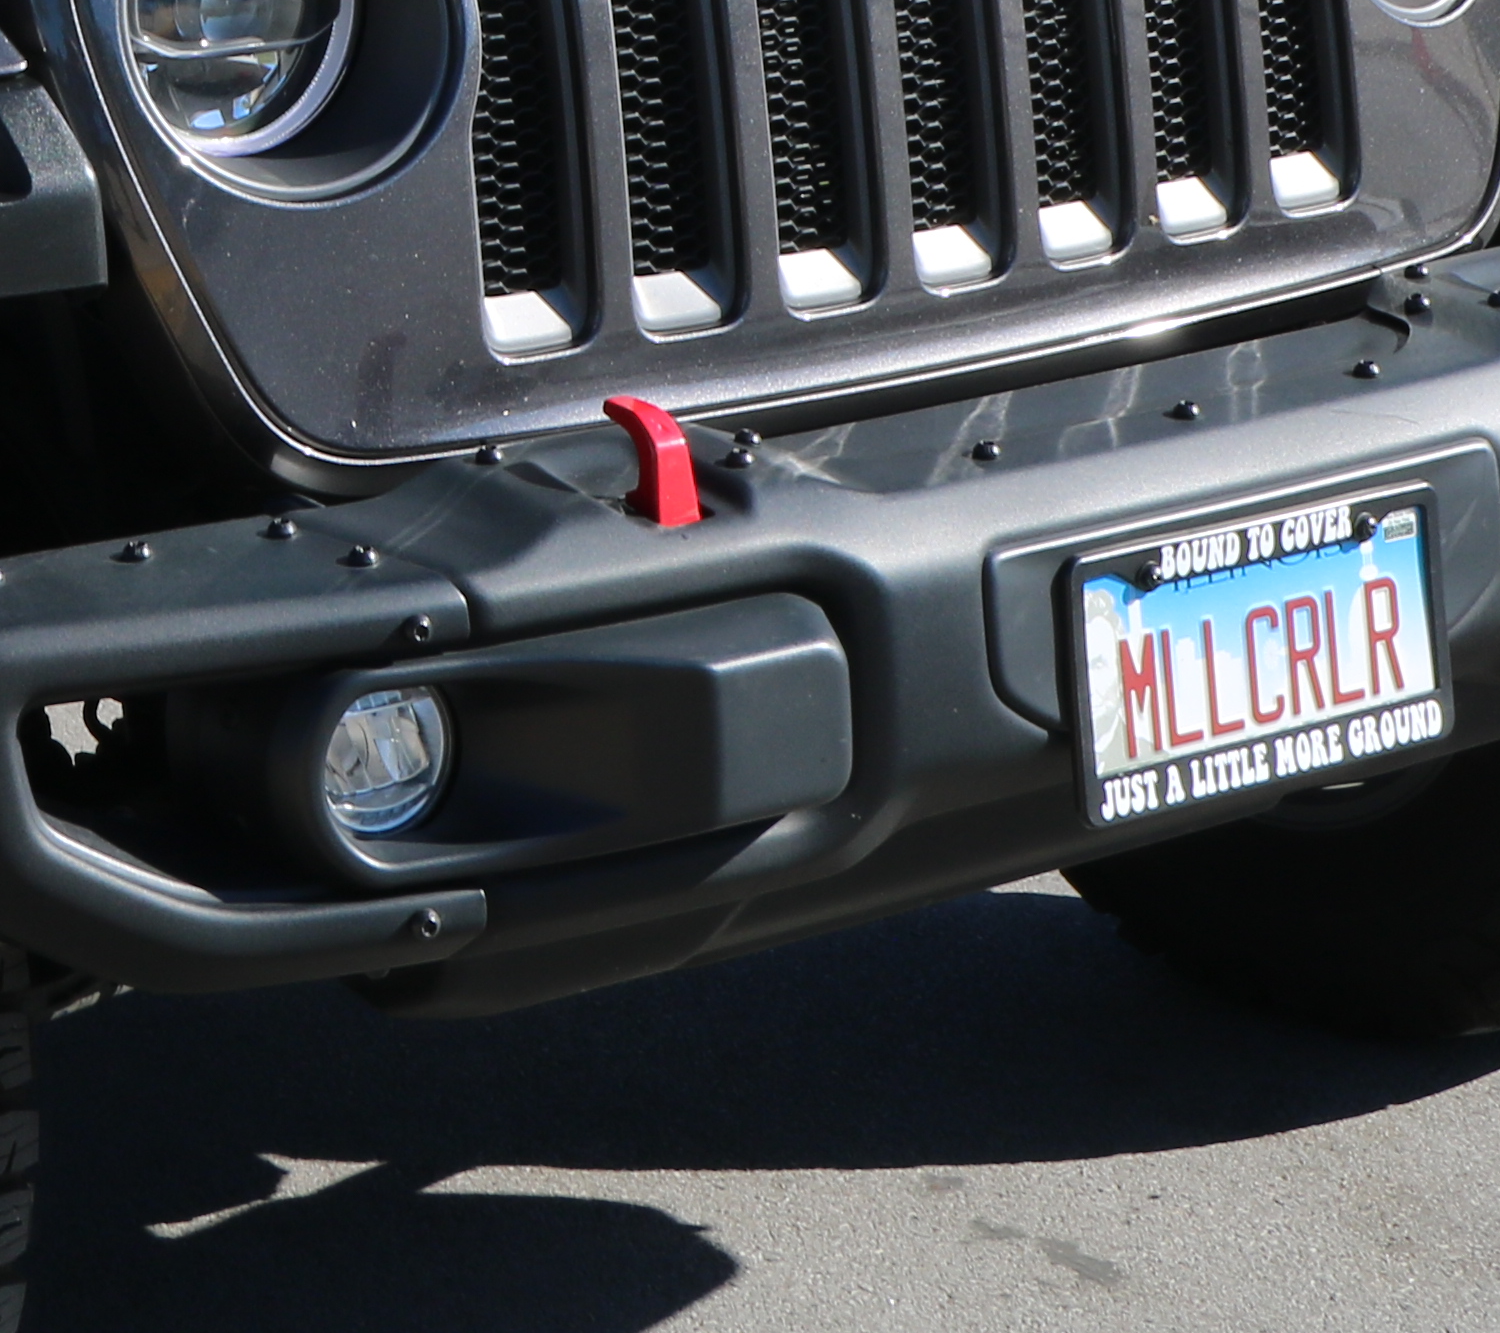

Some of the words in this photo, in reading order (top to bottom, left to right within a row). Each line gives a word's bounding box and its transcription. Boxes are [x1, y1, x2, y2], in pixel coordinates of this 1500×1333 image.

[1160, 532, 1242, 581] BOUND
[1246, 523, 1276, 562] TO
[1280, 505, 1354, 553] COVER
[1118, 575, 1406, 760] MLLCRLR
[1100, 769, 1161, 823] JUST
[1164, 764, 1187, 806] A
[1188, 741, 1270, 798] LITTLE
[1274, 723, 1344, 778] MORE
[1347, 699, 1444, 759] GROUND
